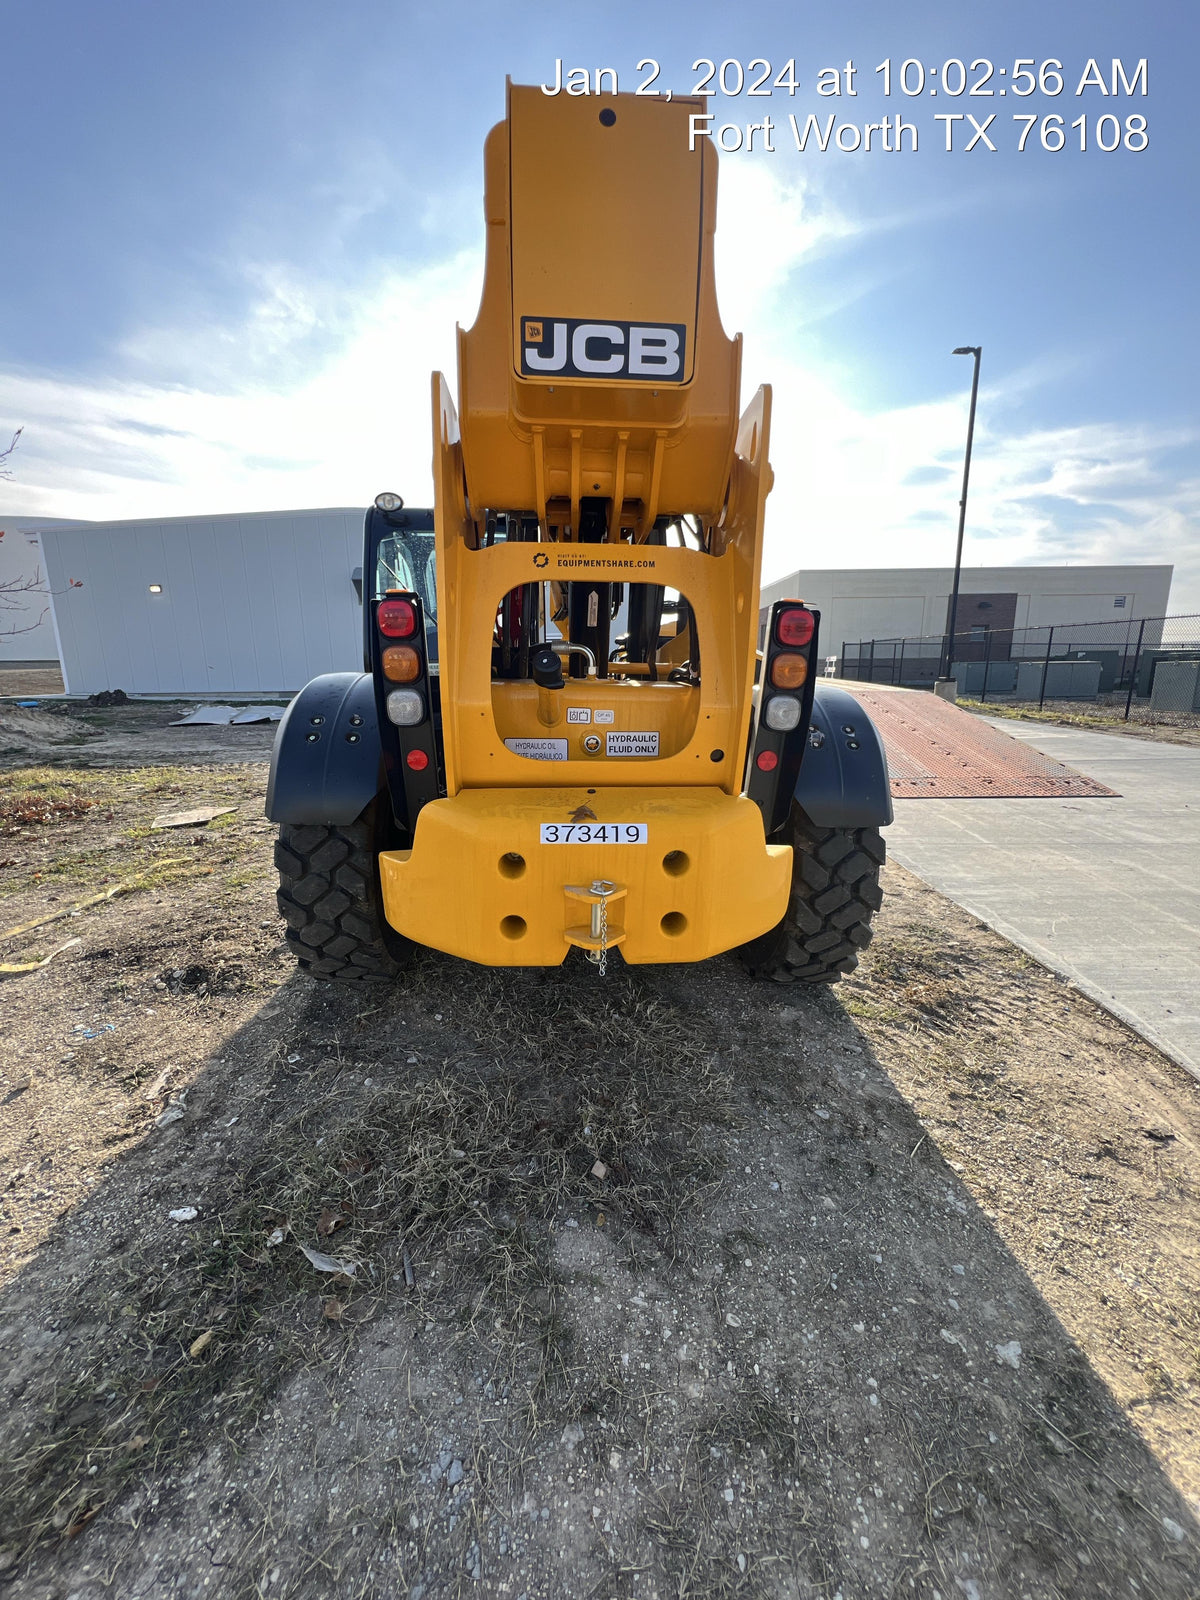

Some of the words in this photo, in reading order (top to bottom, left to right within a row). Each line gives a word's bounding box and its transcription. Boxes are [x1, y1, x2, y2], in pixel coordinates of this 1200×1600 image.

[525, 323, 680, 376] JCB
[557, 559, 656, 568] EQUIPMENTSHARE.COM
[608, 735, 657, 743] HYDRAULIC
[515, 742, 547, 750] HYDRAULIC
[547, 742, 556, 750] OIL
[608, 745, 633, 753] FLUID
[634, 745, 657, 753] ONLY
[545, 825, 640, 843] 373419
